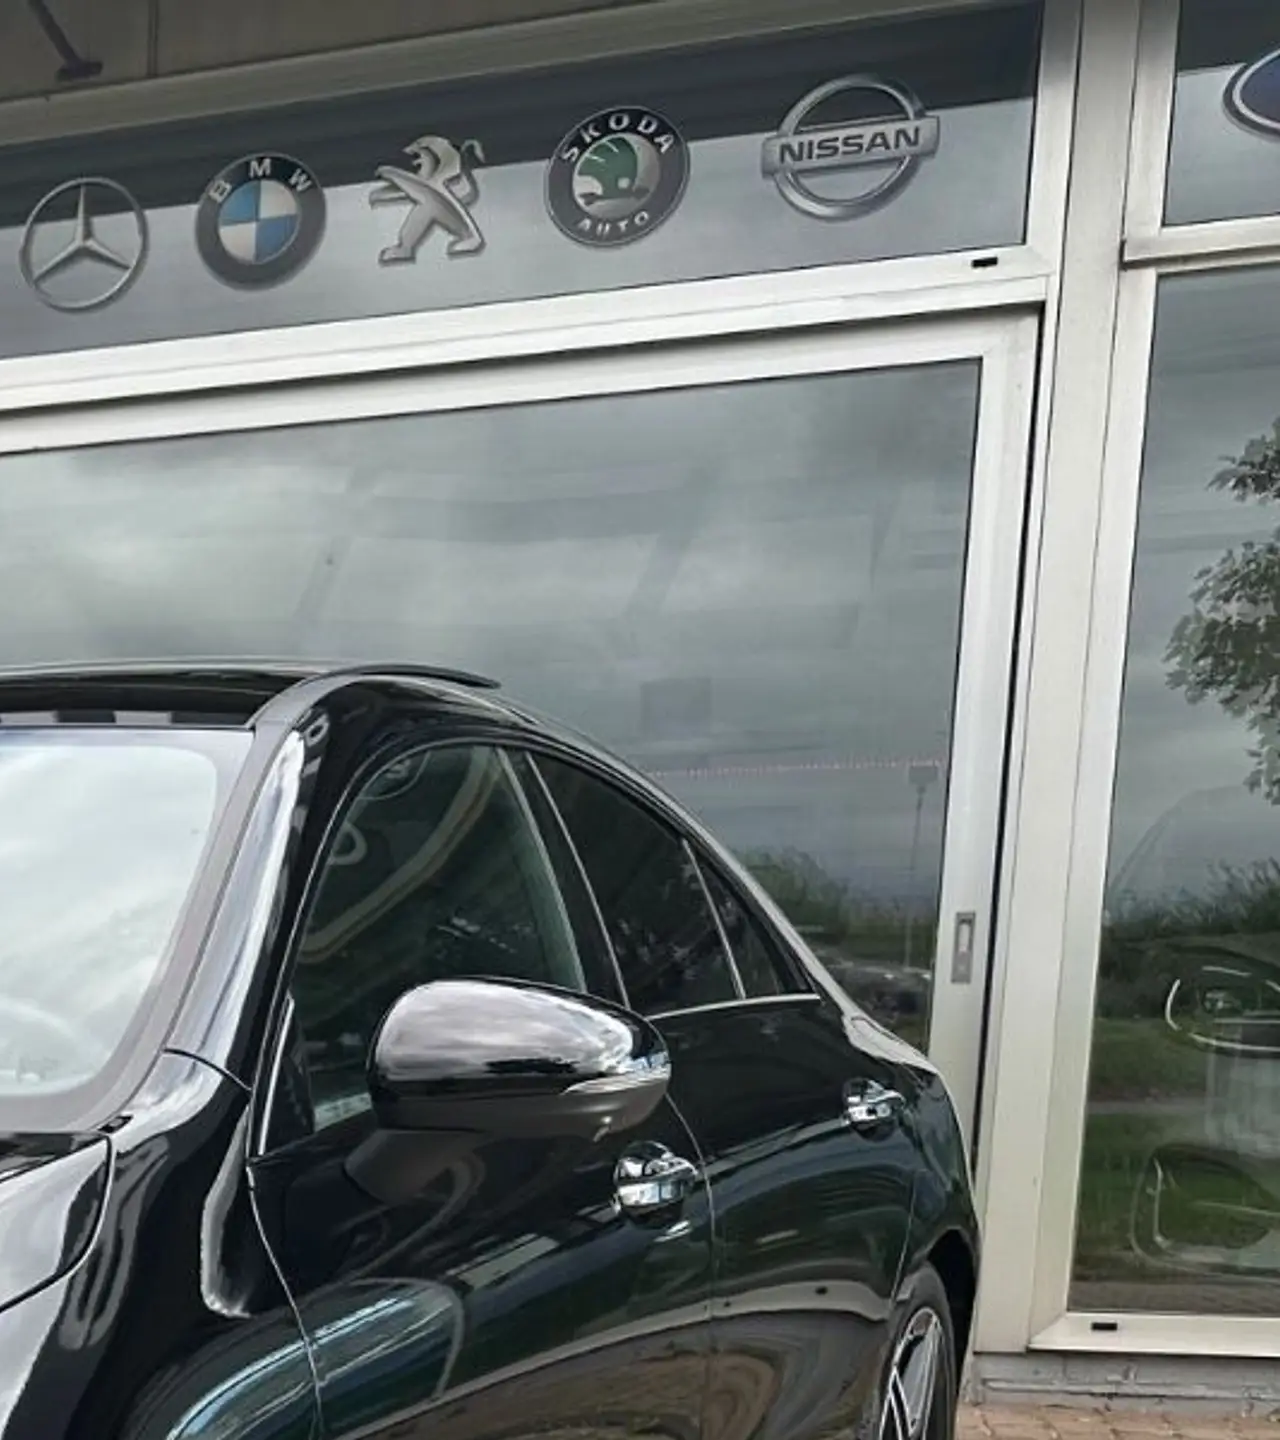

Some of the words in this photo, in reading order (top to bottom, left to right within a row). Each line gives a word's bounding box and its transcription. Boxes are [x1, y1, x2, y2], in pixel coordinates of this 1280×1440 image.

[778, 126, 921, 164] NISSAN
[208, 158, 312, 202] BMW
[577, 210, 649, 237] AUTO
